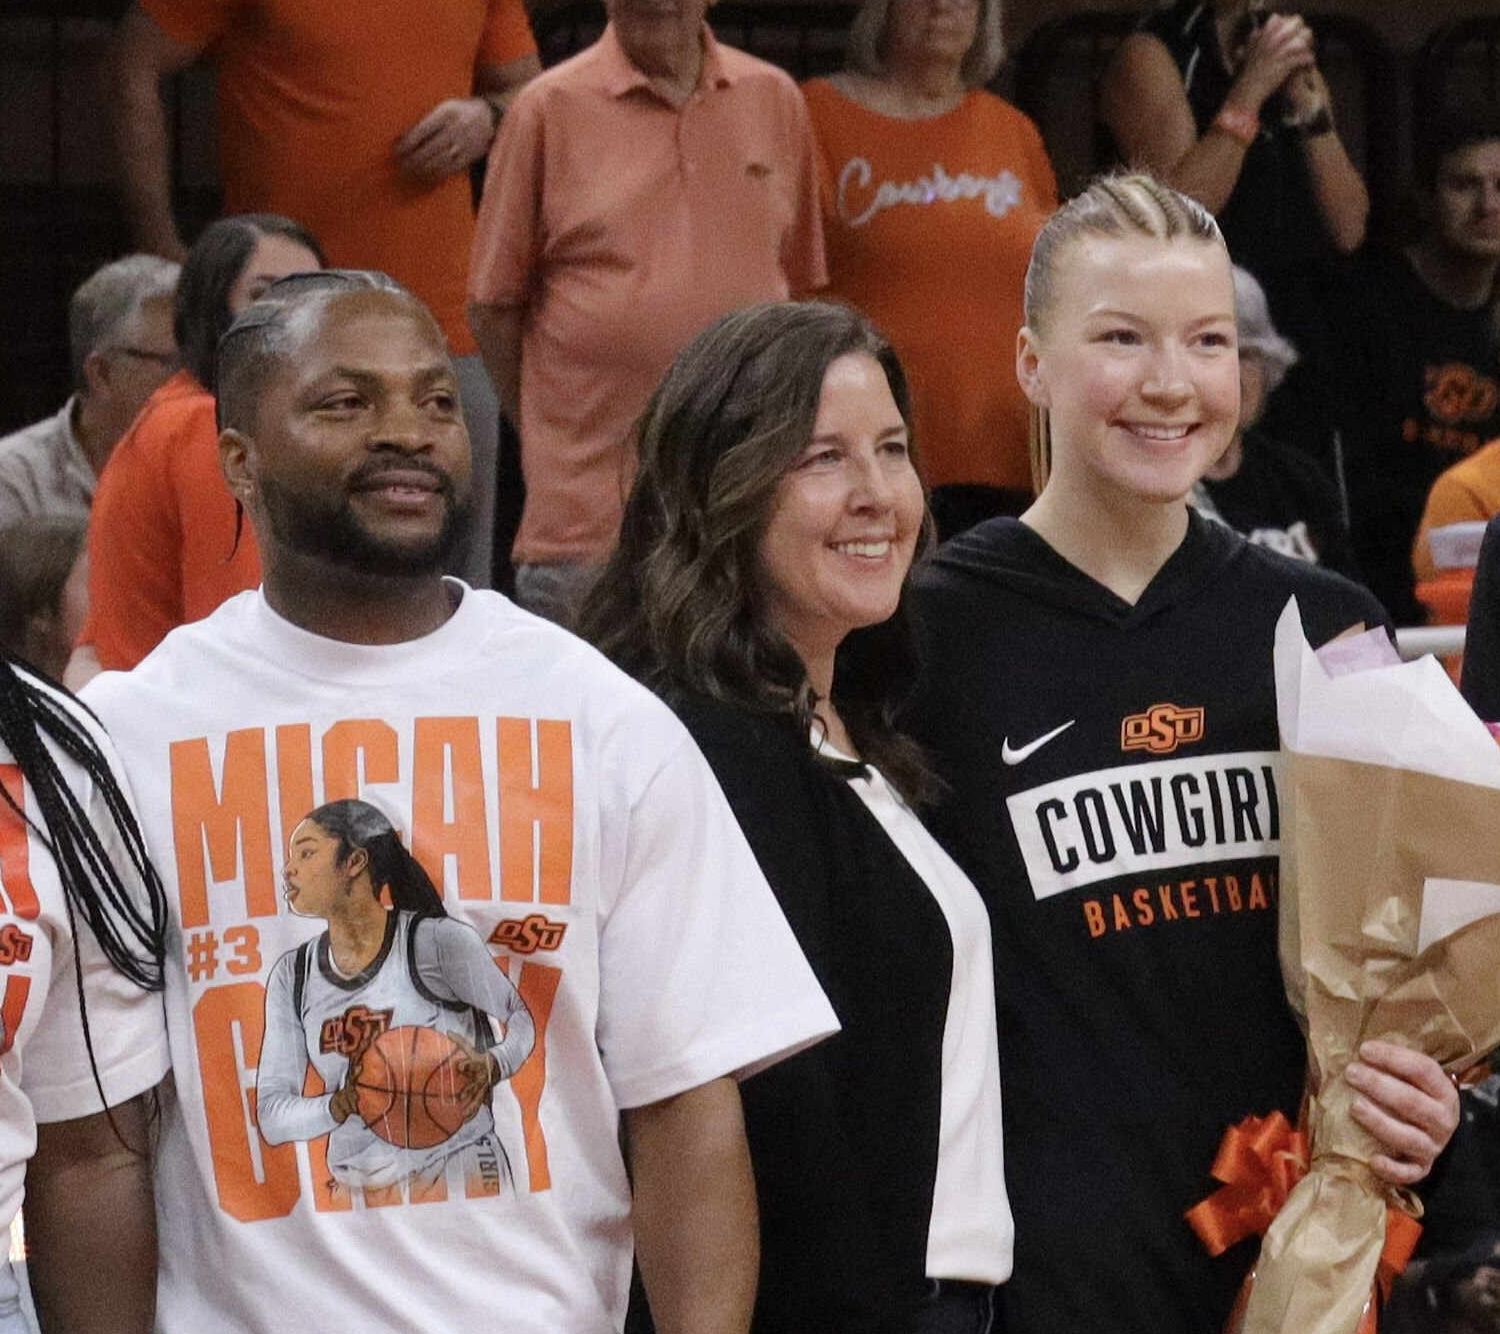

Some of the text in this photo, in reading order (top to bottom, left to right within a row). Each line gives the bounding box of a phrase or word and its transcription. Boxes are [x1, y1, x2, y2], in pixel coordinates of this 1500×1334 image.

[1121, 703, 1205, 754] OSU
[170, 716, 573, 929] MICAH
[1035, 765, 1280, 875] COWGIRL
[489, 913, 569, 955] OSU
[1083, 873, 1272, 938] BASKETBA
[187, 924, 264, 983] #3
